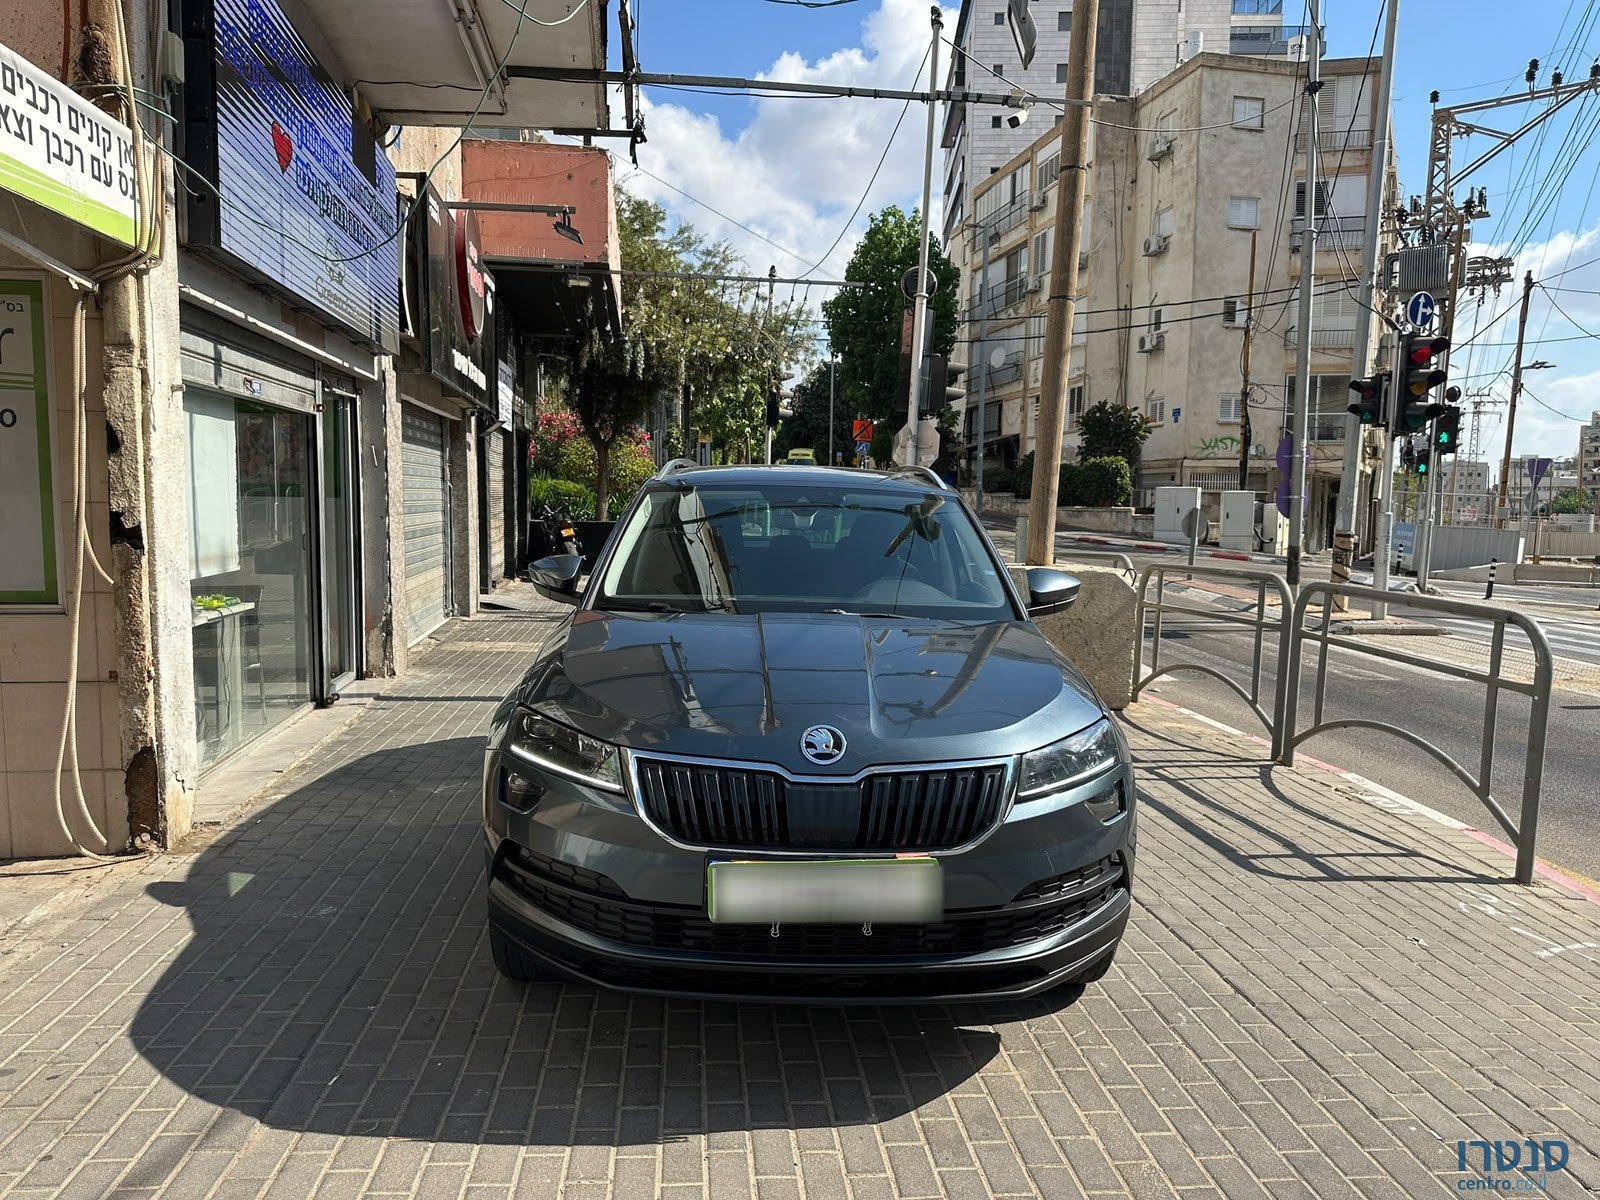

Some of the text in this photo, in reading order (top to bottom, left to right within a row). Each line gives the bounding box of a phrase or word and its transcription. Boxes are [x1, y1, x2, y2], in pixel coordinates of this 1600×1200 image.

[1, 61, 135, 168] אן קונים רכבים
[40, 124, 85, 174] רכבך
[91, 154, 113, 188] עם
[118, 170, 139, 204] נס
